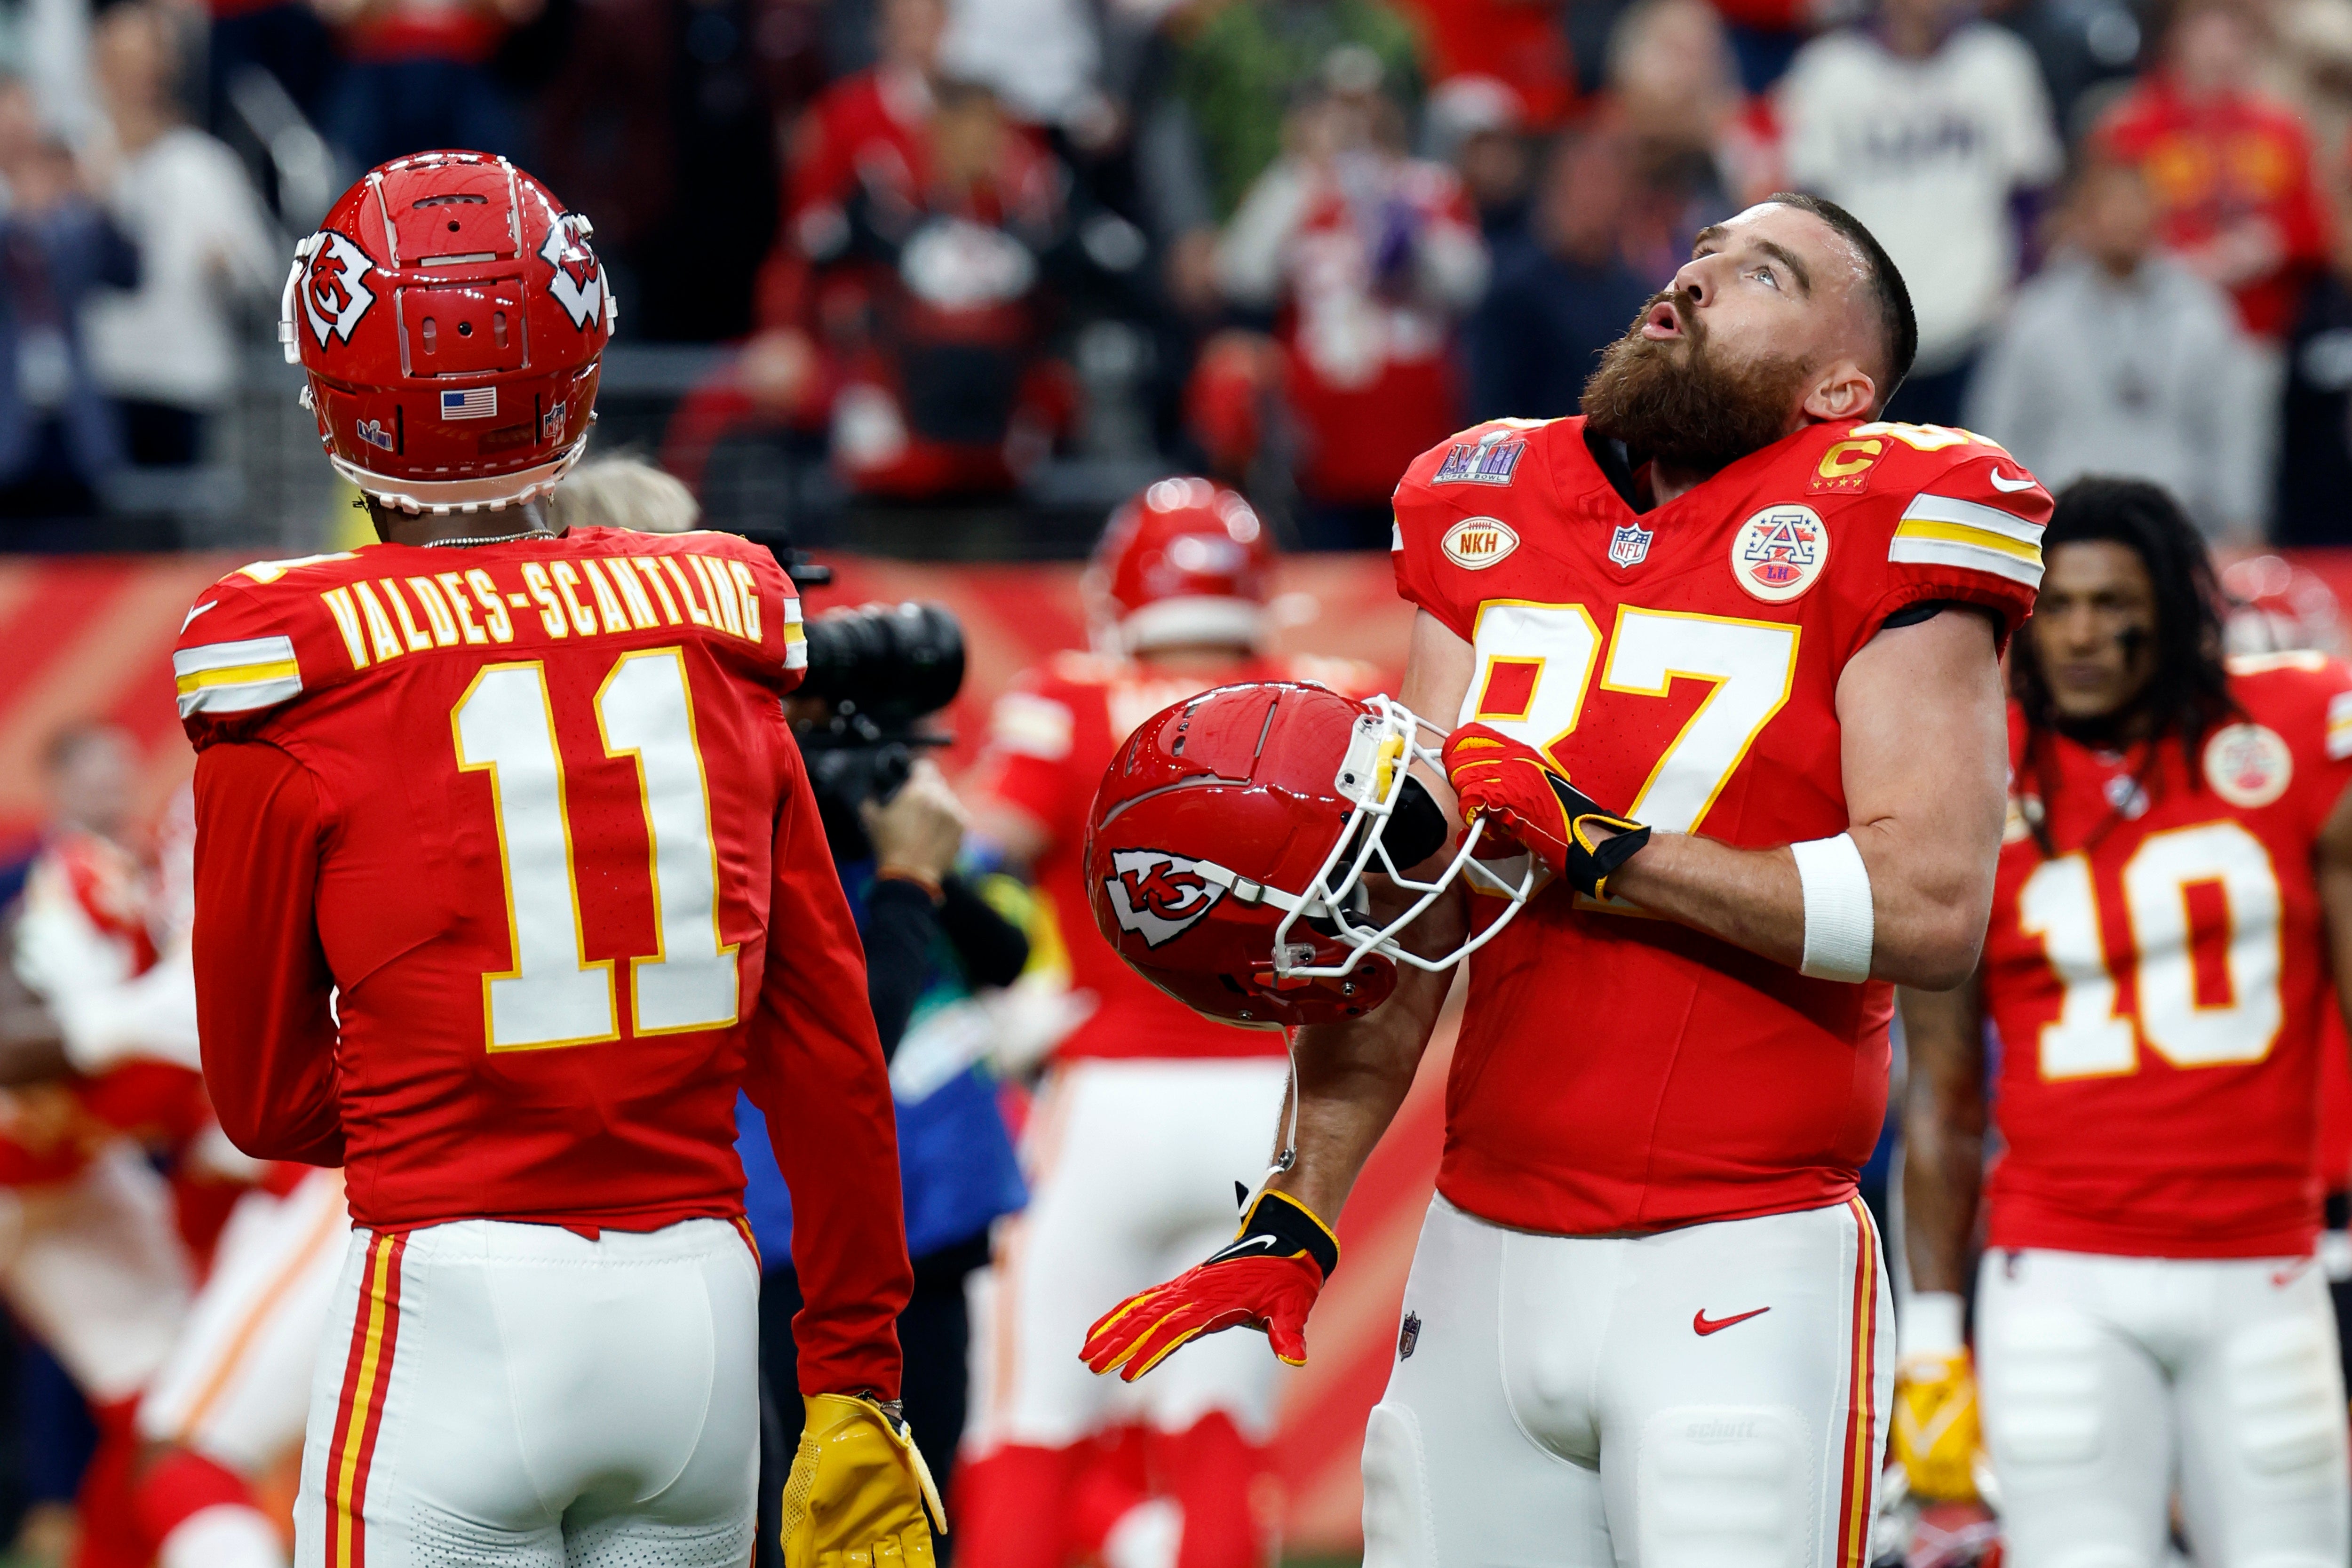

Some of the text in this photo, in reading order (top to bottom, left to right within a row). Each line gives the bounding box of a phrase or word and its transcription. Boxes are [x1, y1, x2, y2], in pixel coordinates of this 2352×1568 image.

[1818, 439, 1882, 478] C
[1460, 532, 1498, 554] NKH
[1615, 541, 1641, 559] NFL
[1767, 565, 1788, 580] LH
[321, 556, 763, 670] VALDES-SCANTLING
[1457, 599, 1802, 917] 87
[450, 646, 740, 1053] 11
[1120, 860, 1211, 921] KC
[2017, 819, 2282, 1082] 10
